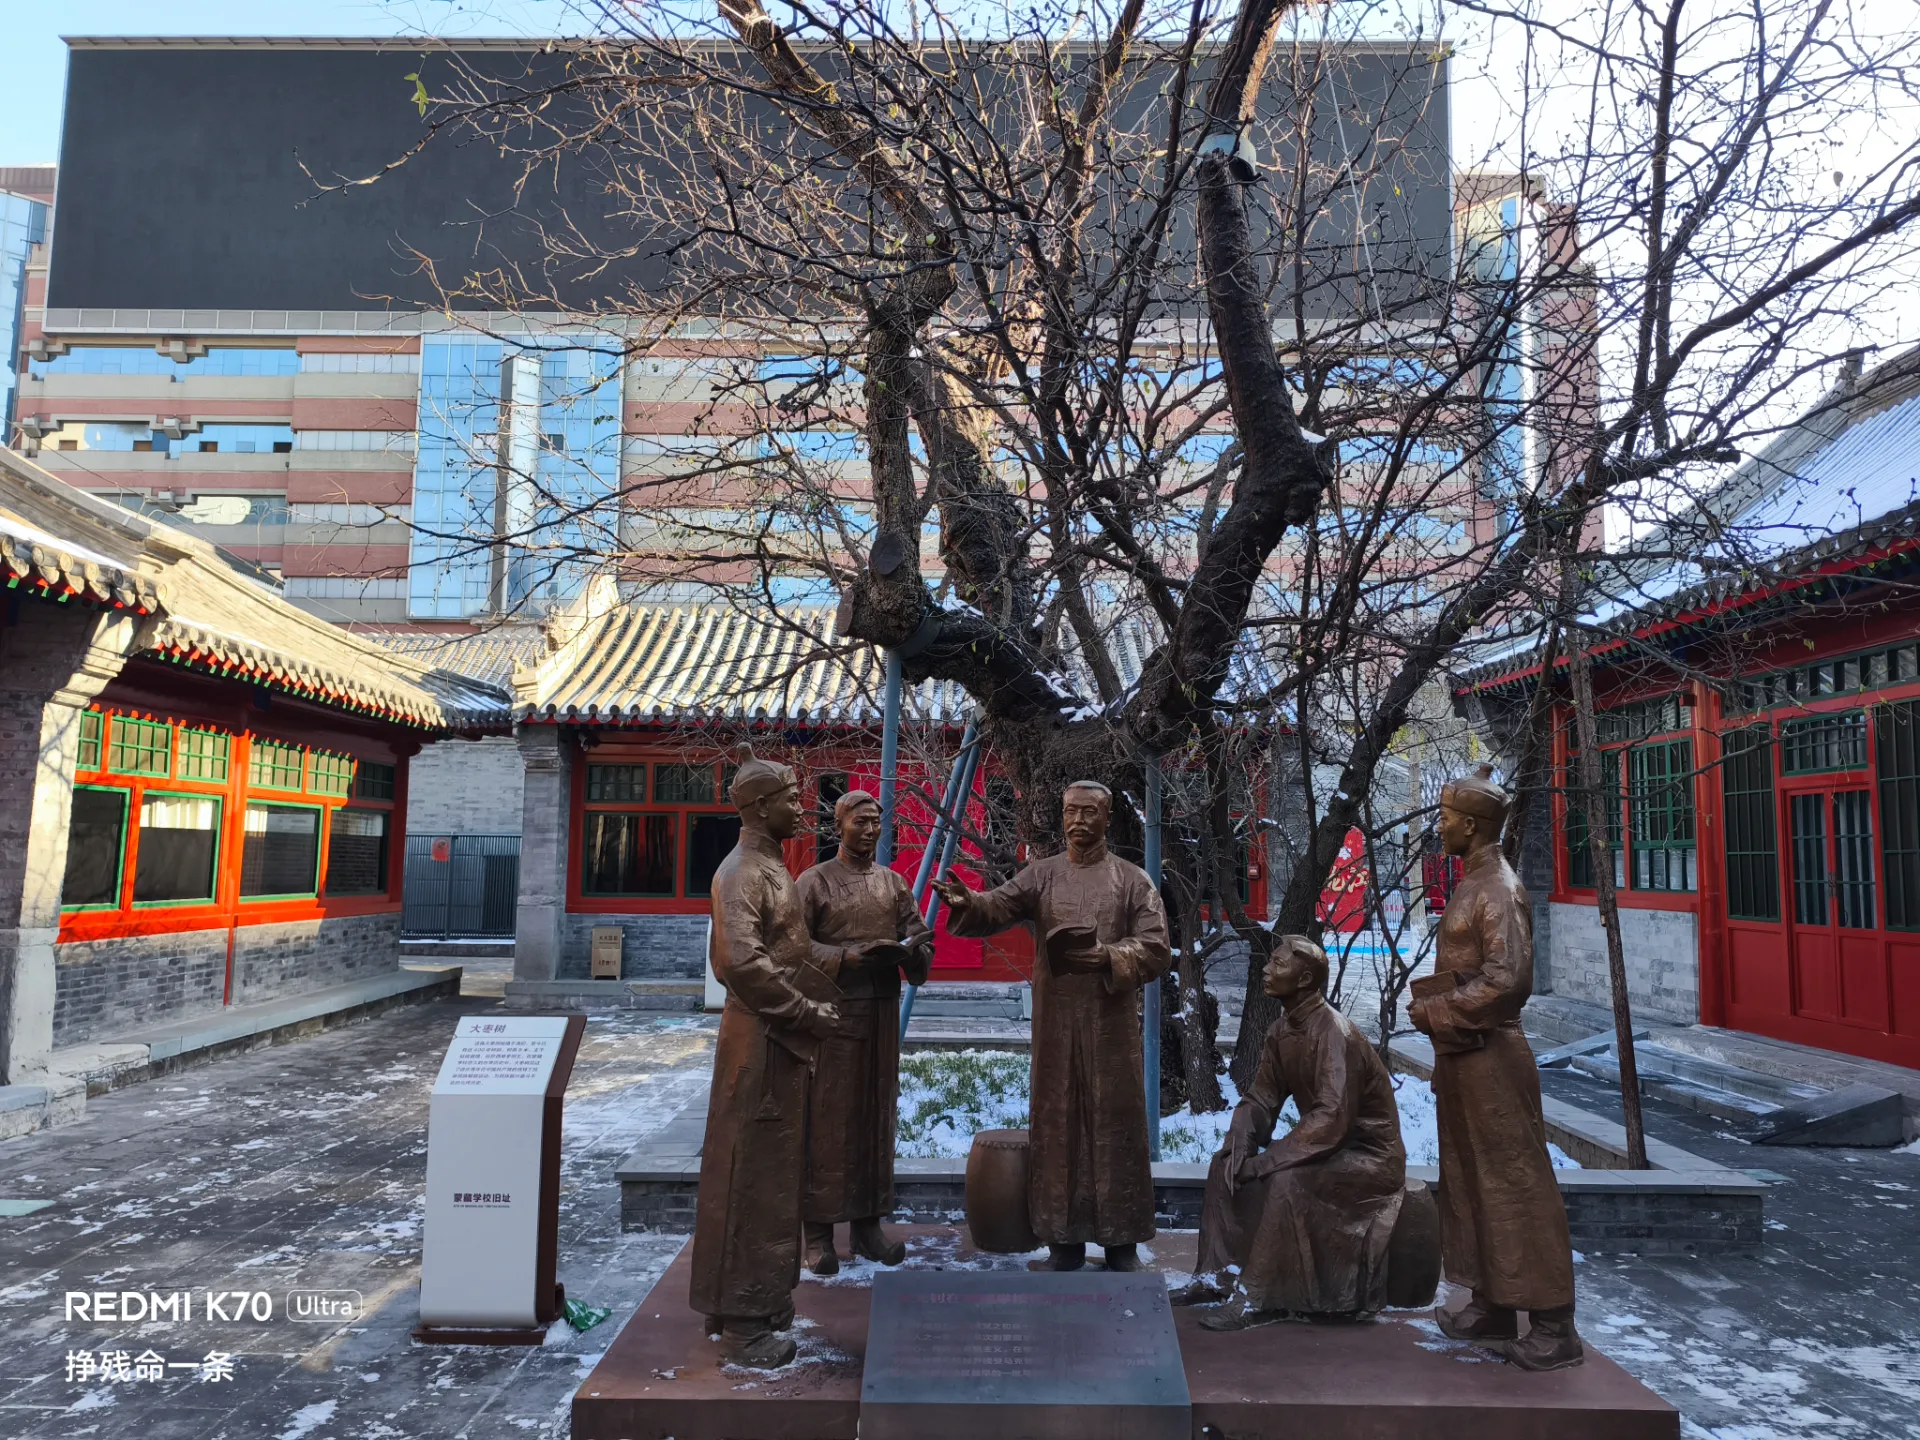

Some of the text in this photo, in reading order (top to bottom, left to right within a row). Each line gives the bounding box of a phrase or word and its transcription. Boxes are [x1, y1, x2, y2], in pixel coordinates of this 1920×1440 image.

[470, 1024, 506, 1033] 大枣树
[453, 1193, 511, 1203] 蒙藏学校旧址
